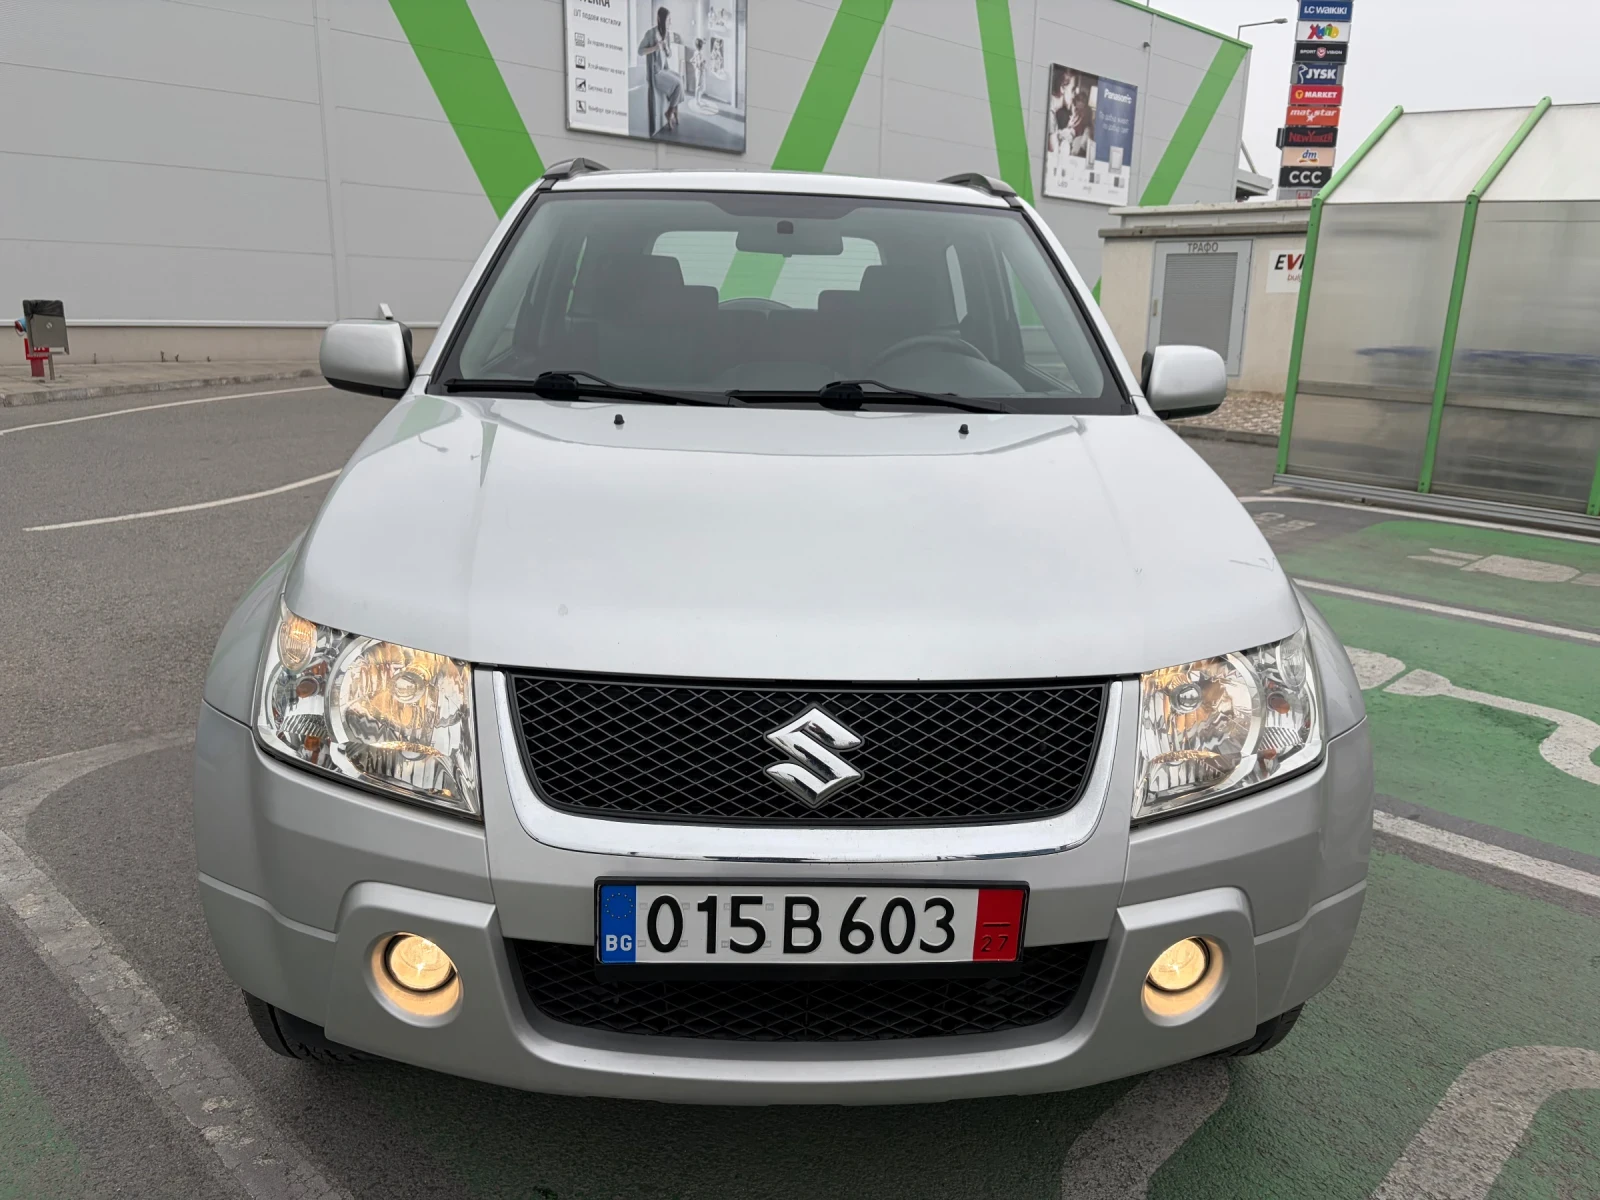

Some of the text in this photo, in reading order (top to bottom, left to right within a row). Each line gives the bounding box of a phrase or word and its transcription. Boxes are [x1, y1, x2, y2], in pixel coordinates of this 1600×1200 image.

[1304, 6, 1315, 14] LC
[1306, 69, 1336, 79] JYSK
[1104, 88, 1132, 104] Panasonic
[1302, 150, 1317, 158] dm
[1289, 171, 1322, 183] CCC
[1187, 242, 1219, 254] ТРАФО
[605, 934, 633, 952] BG
